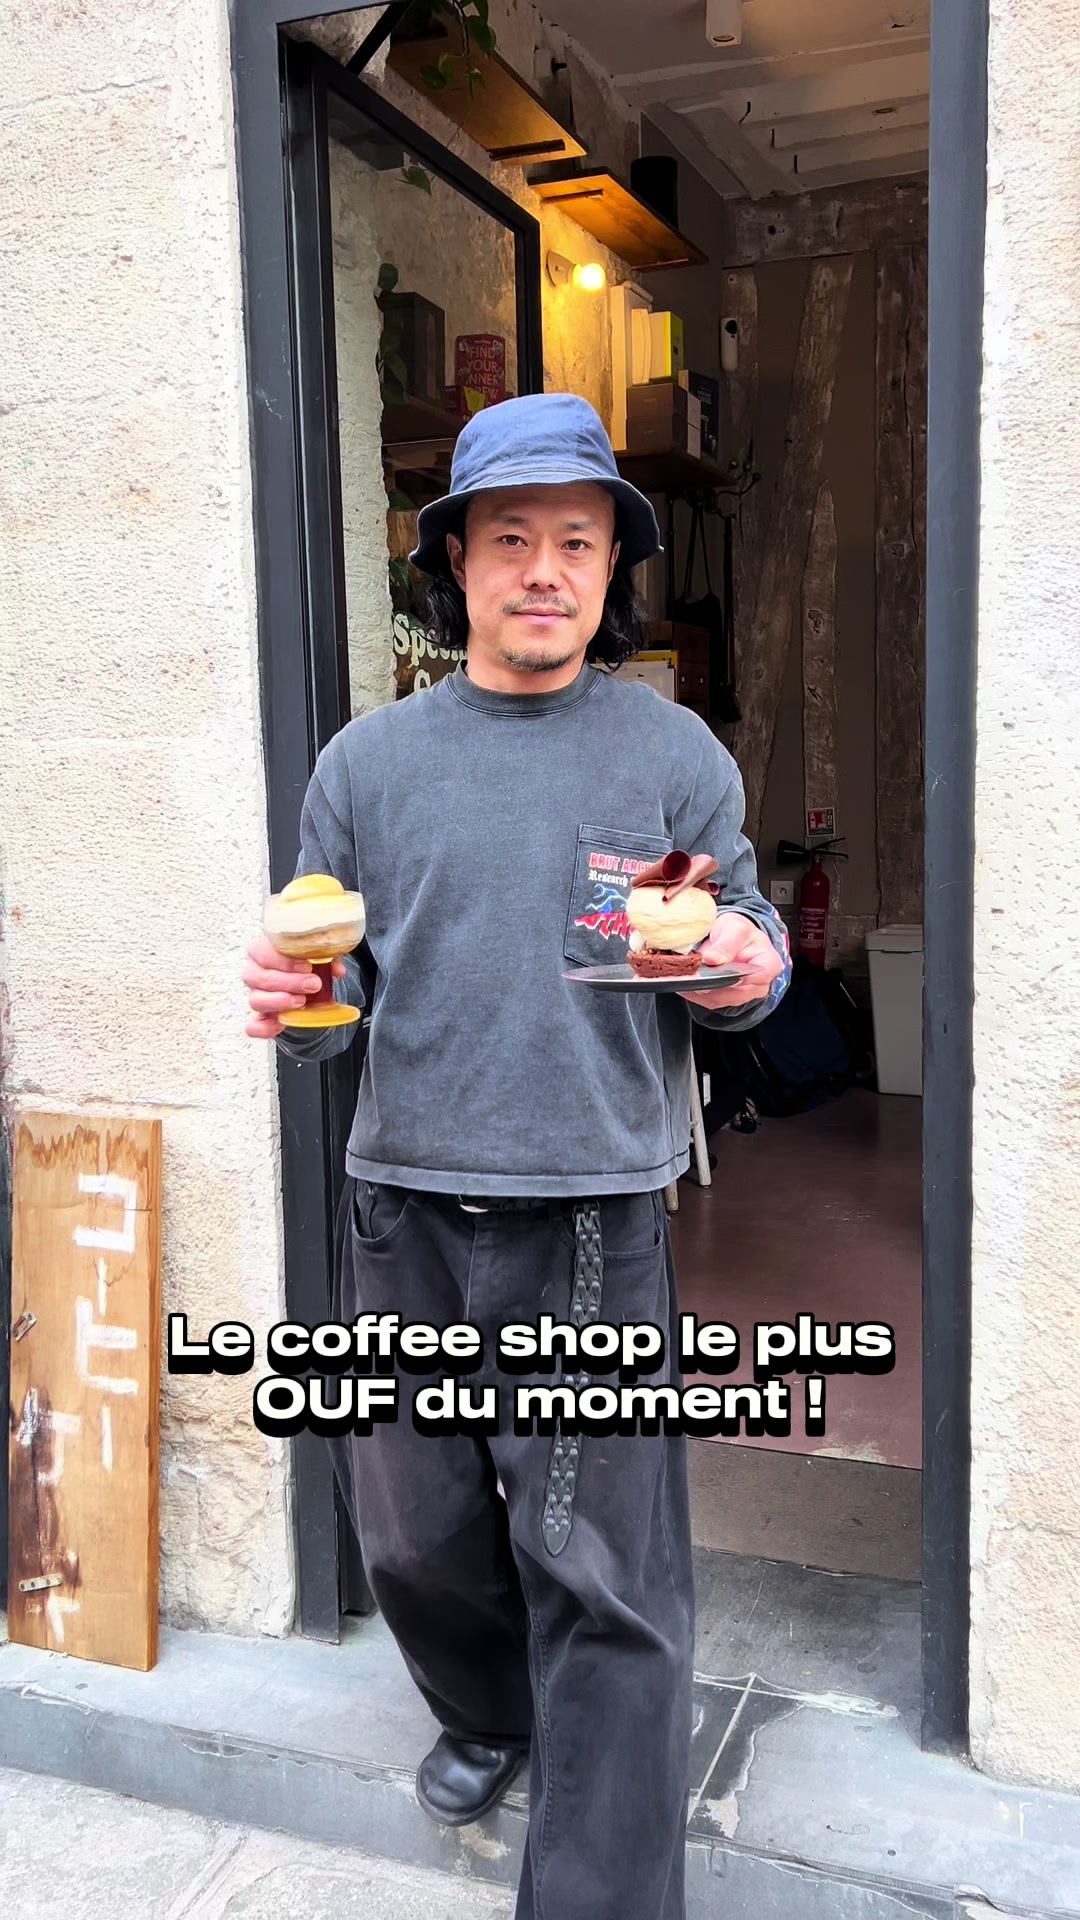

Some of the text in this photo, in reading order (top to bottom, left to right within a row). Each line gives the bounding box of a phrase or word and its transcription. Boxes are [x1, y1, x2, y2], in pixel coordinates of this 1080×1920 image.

[469, 346, 496, 359] FIND
[466, 359, 498, 372] YOUR
[589, 852, 621, 871] BRUT
[588, 870, 629, 887] Research
[72, 1172, 138, 1472] コーヒー
